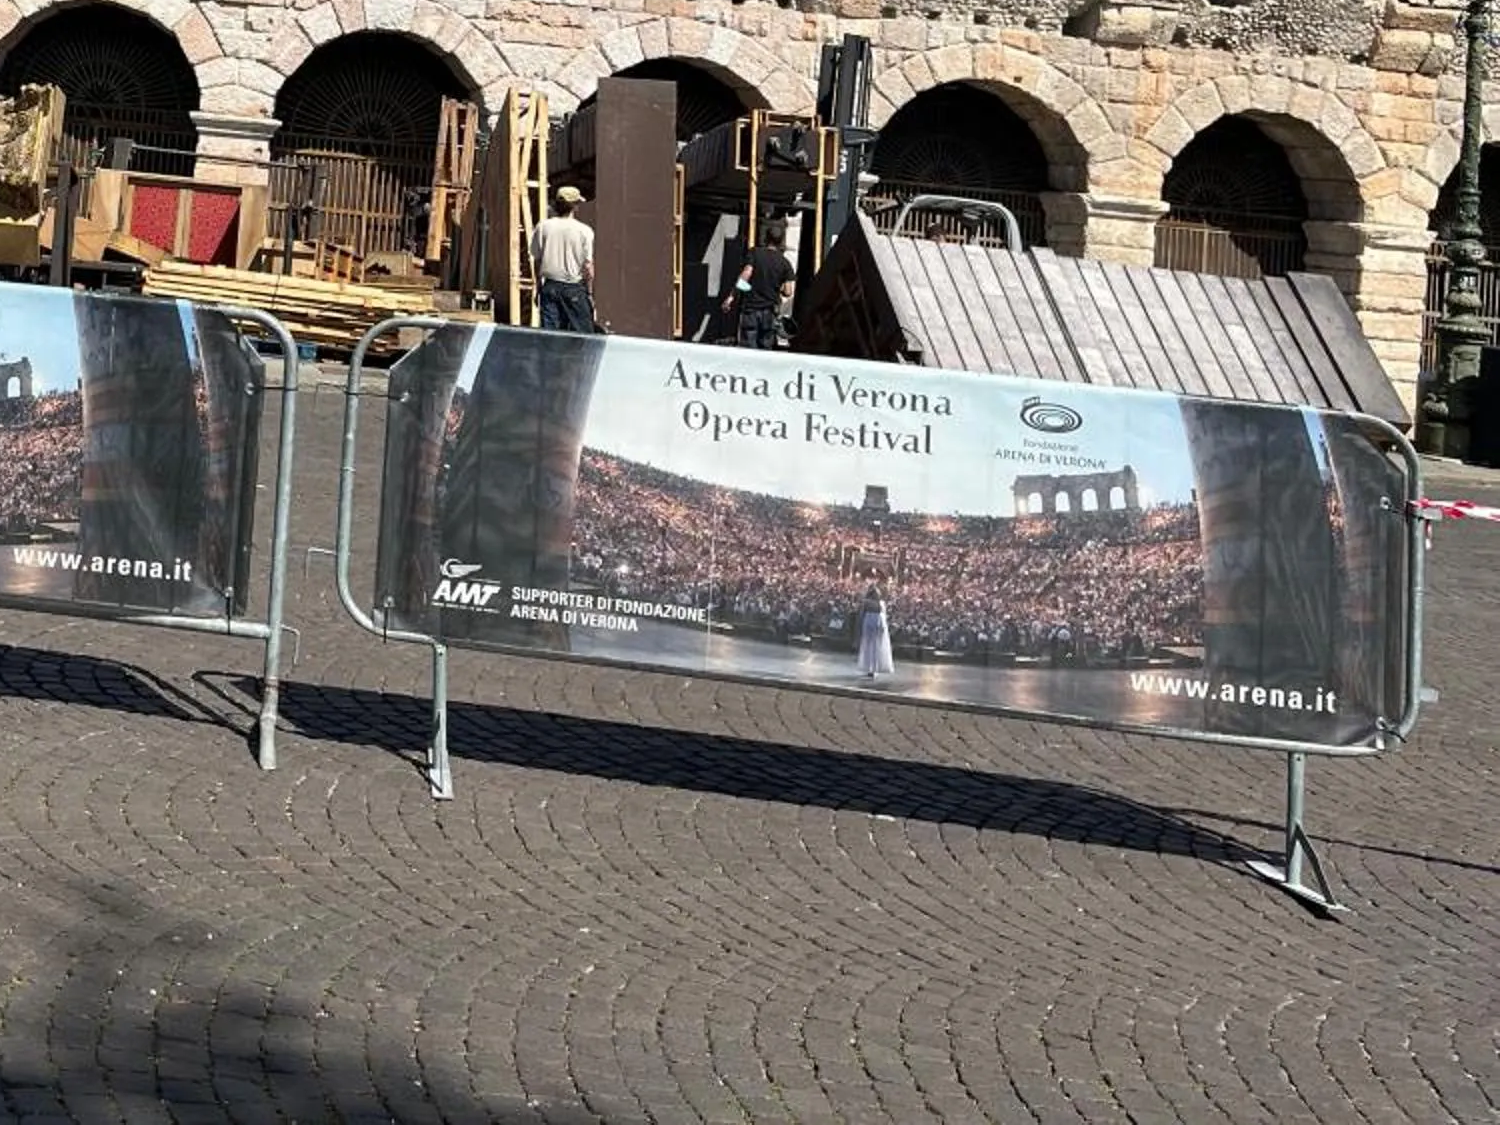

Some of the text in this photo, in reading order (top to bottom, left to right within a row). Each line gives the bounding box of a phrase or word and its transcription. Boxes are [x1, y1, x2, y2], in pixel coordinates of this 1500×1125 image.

[664, 358, 953, 416] Arena di Verona
[682, 400, 932, 455] Opera Festival
[13, 547, 192, 582] www.arena.it
[432, 579, 501, 606] AMT
[511, 586, 593, 609] SUPPORTER
[597, 596, 612, 611] DI
[615, 597, 707, 623] FONDAZIONE
[510, 604, 558, 623] ARENA
[562, 609, 577, 624] DI
[580, 610, 638, 632] VERONA
[1130, 673, 1337, 714] www.arena.it
